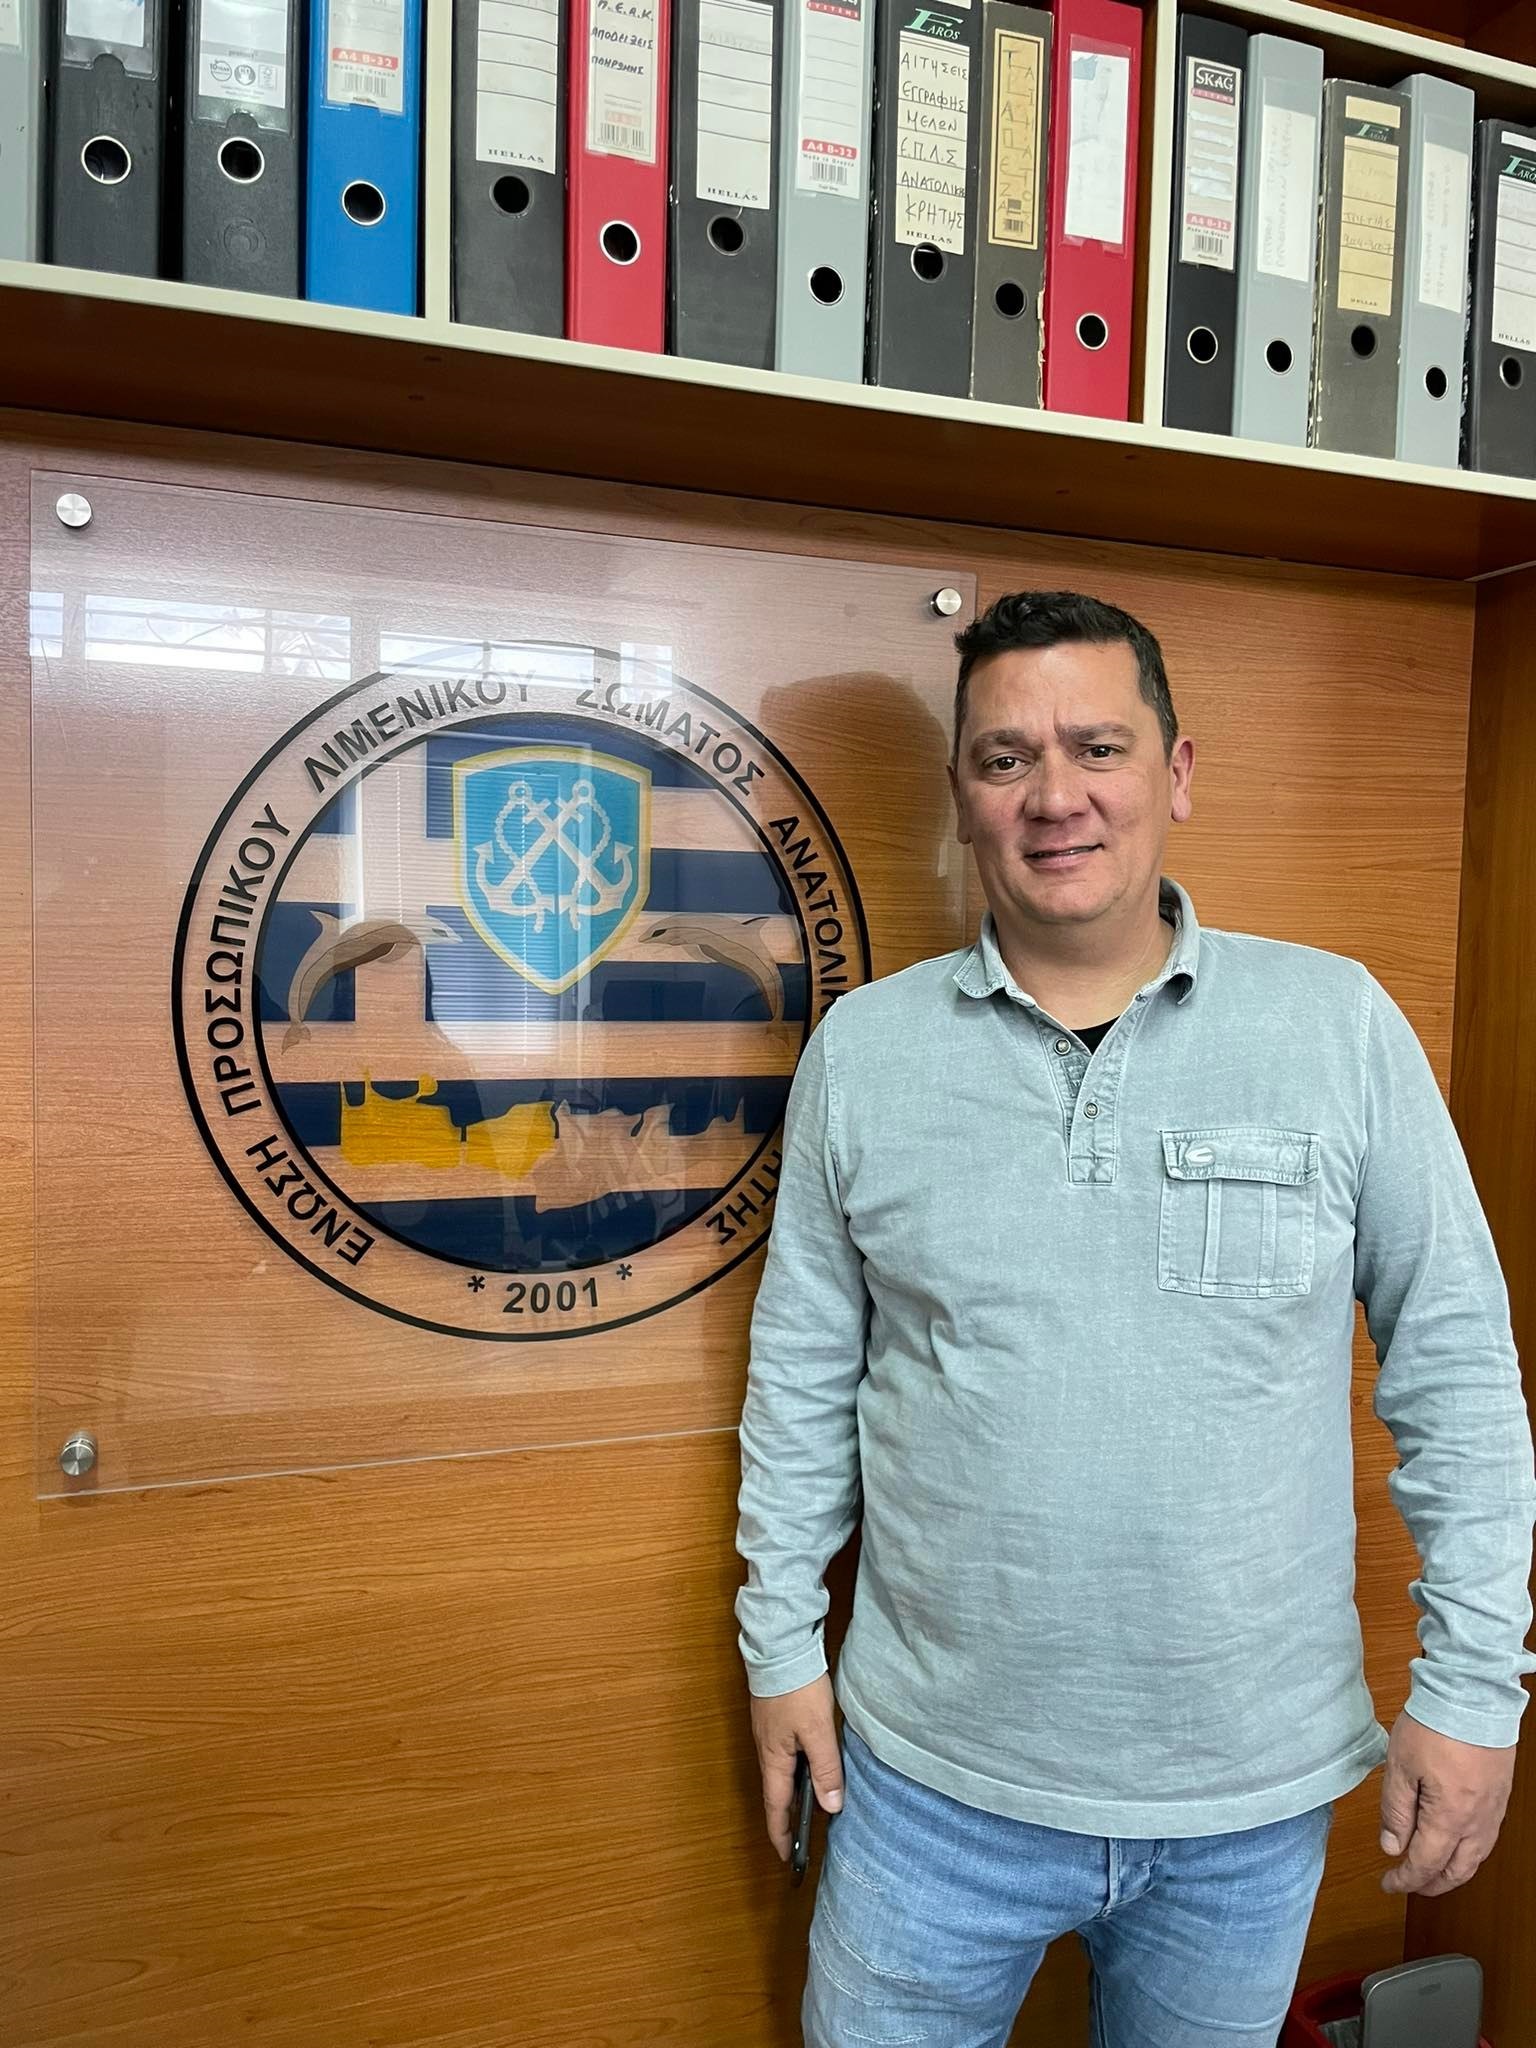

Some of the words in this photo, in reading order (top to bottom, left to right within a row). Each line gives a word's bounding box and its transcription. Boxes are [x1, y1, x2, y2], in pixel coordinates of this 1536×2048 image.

[904, 8, 964, 40] FAROS
[901, 52, 968, 81] ΑΙΤΗΣΕΙΣ
[1195, 66, 1234, 92] SKAG
[902, 81, 965, 111] ΕΓΓΡΑΦΗΣ
[907, 109, 957, 132] ΜΕΛΩΝ
[488, 148, 545, 163] HELLAS
[807, 141, 824, 152] A4
[827, 144, 853, 158] B-32
[1501, 154, 1536, 182] FARO
[707, 186, 759, 202] HELLAS
[905, 192, 964, 231] ΚΡΗΤΗΣ
[906, 230, 953, 245] HELLAS
[1498, 332, 1530, 345] HELLAS
[303, 669, 534, 793] ΛΙΜΕΝΙΚΟΥ
[576, 676, 765, 797] ΣΩΜΑΤΟΣ
[768, 815, 848, 1015] ΑΝΑΤΟΛΙΚ
[205, 802, 291, 1117] ΠΡΟΣΩΠΙΚΟΥ
[246, 1134, 376, 1266] ΕΝΩΣΗ
[502, 1277, 599, 1314] 2001
